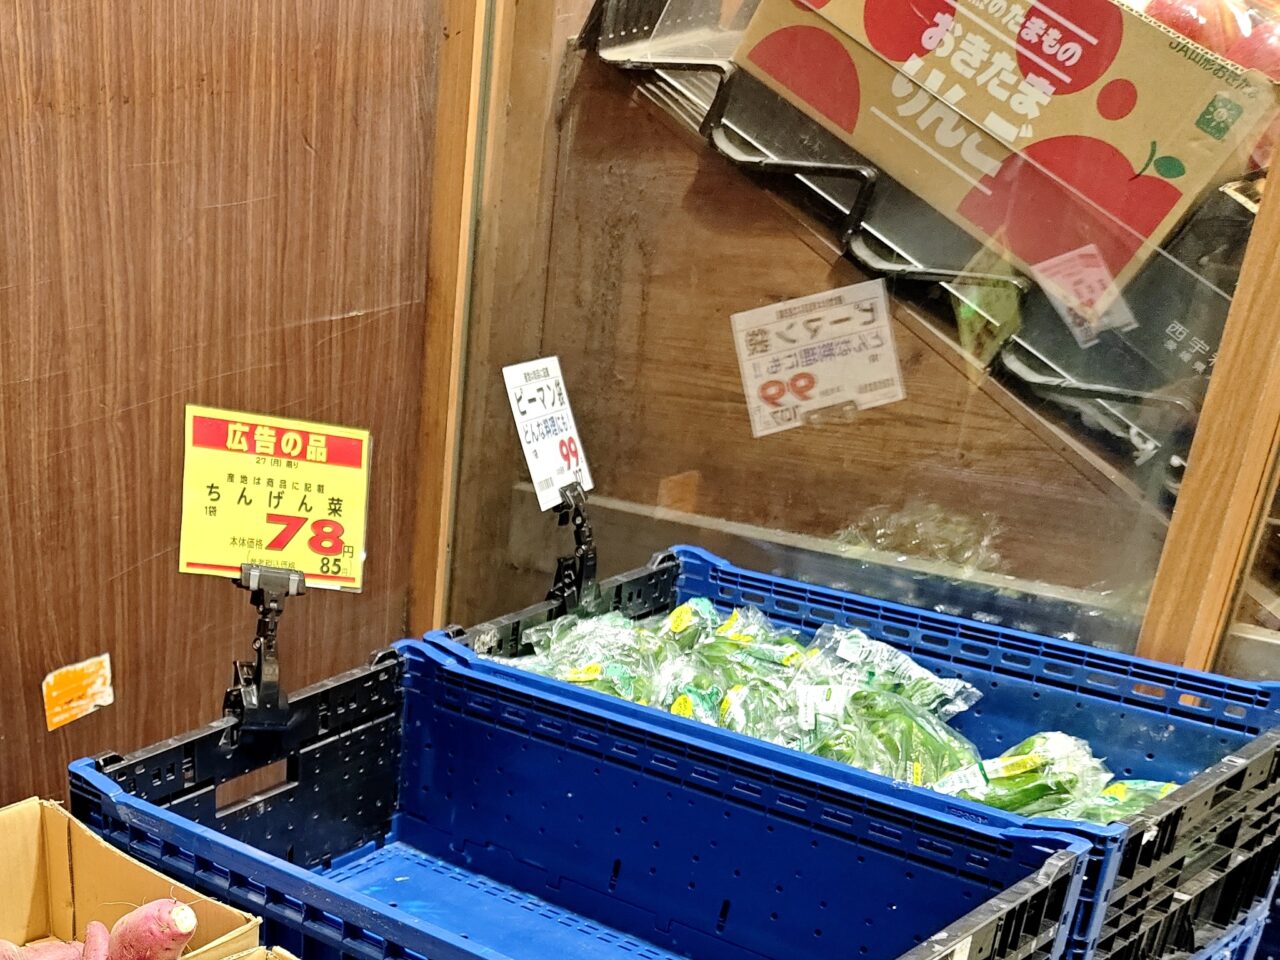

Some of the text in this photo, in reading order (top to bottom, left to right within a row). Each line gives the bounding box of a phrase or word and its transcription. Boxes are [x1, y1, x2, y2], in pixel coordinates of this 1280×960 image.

[921, 12, 1057, 120] おきたま
[891, 53, 1034, 178] りんご
[225, 422, 328, 463] 広告の品
[559, 437, 579, 472] 99
[206, 482, 344, 518] ちんげん菜
